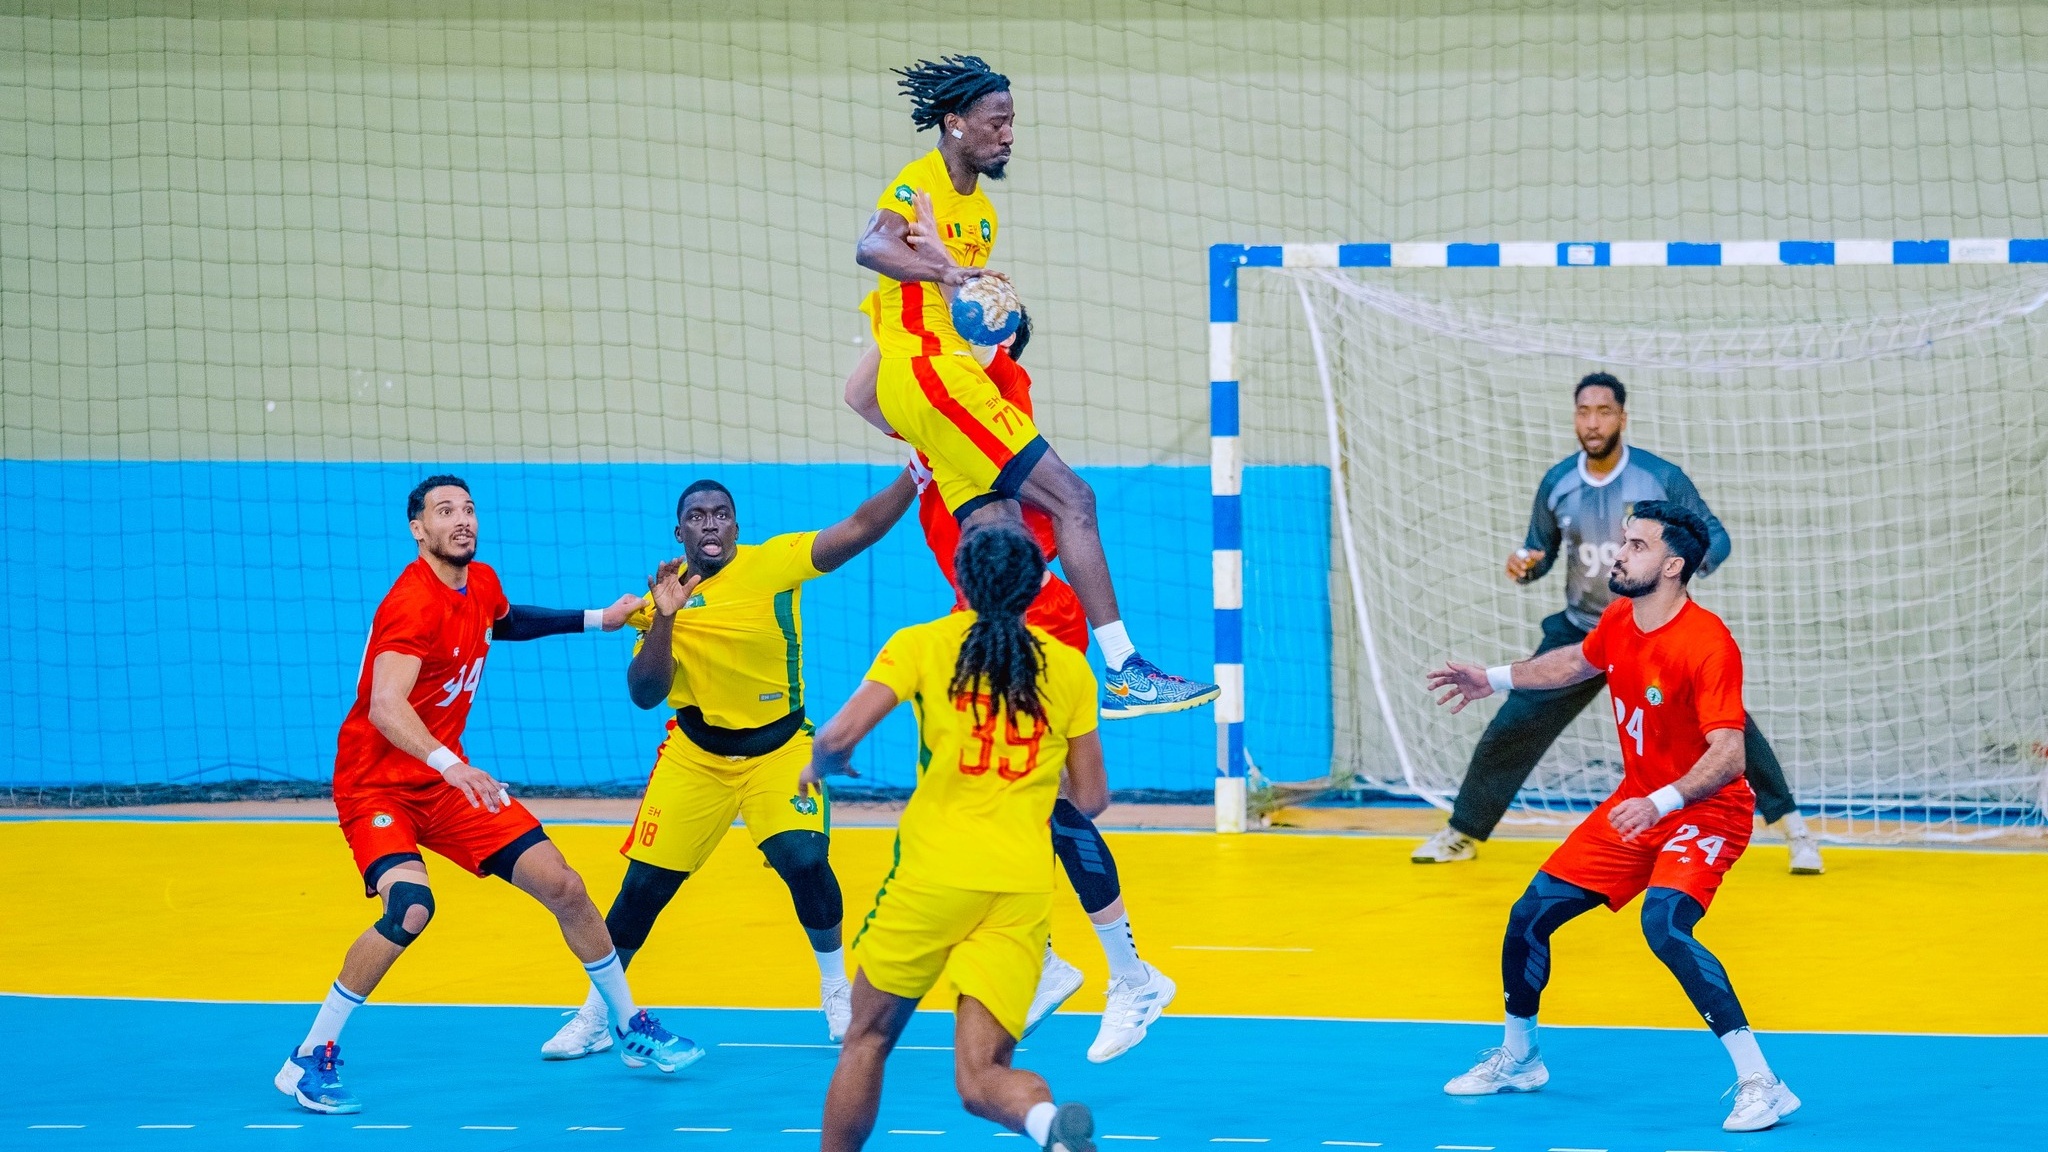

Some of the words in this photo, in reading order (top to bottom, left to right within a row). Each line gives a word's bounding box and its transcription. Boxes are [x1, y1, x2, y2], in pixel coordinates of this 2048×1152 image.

[992, 405, 1024, 437] 77
[1578, 541, 1621, 578] 99
[435, 657, 484, 707] 94
[955, 691, 1047, 781] 39
[639, 821, 659, 848] 18
[1661, 823, 1727, 866] 24
